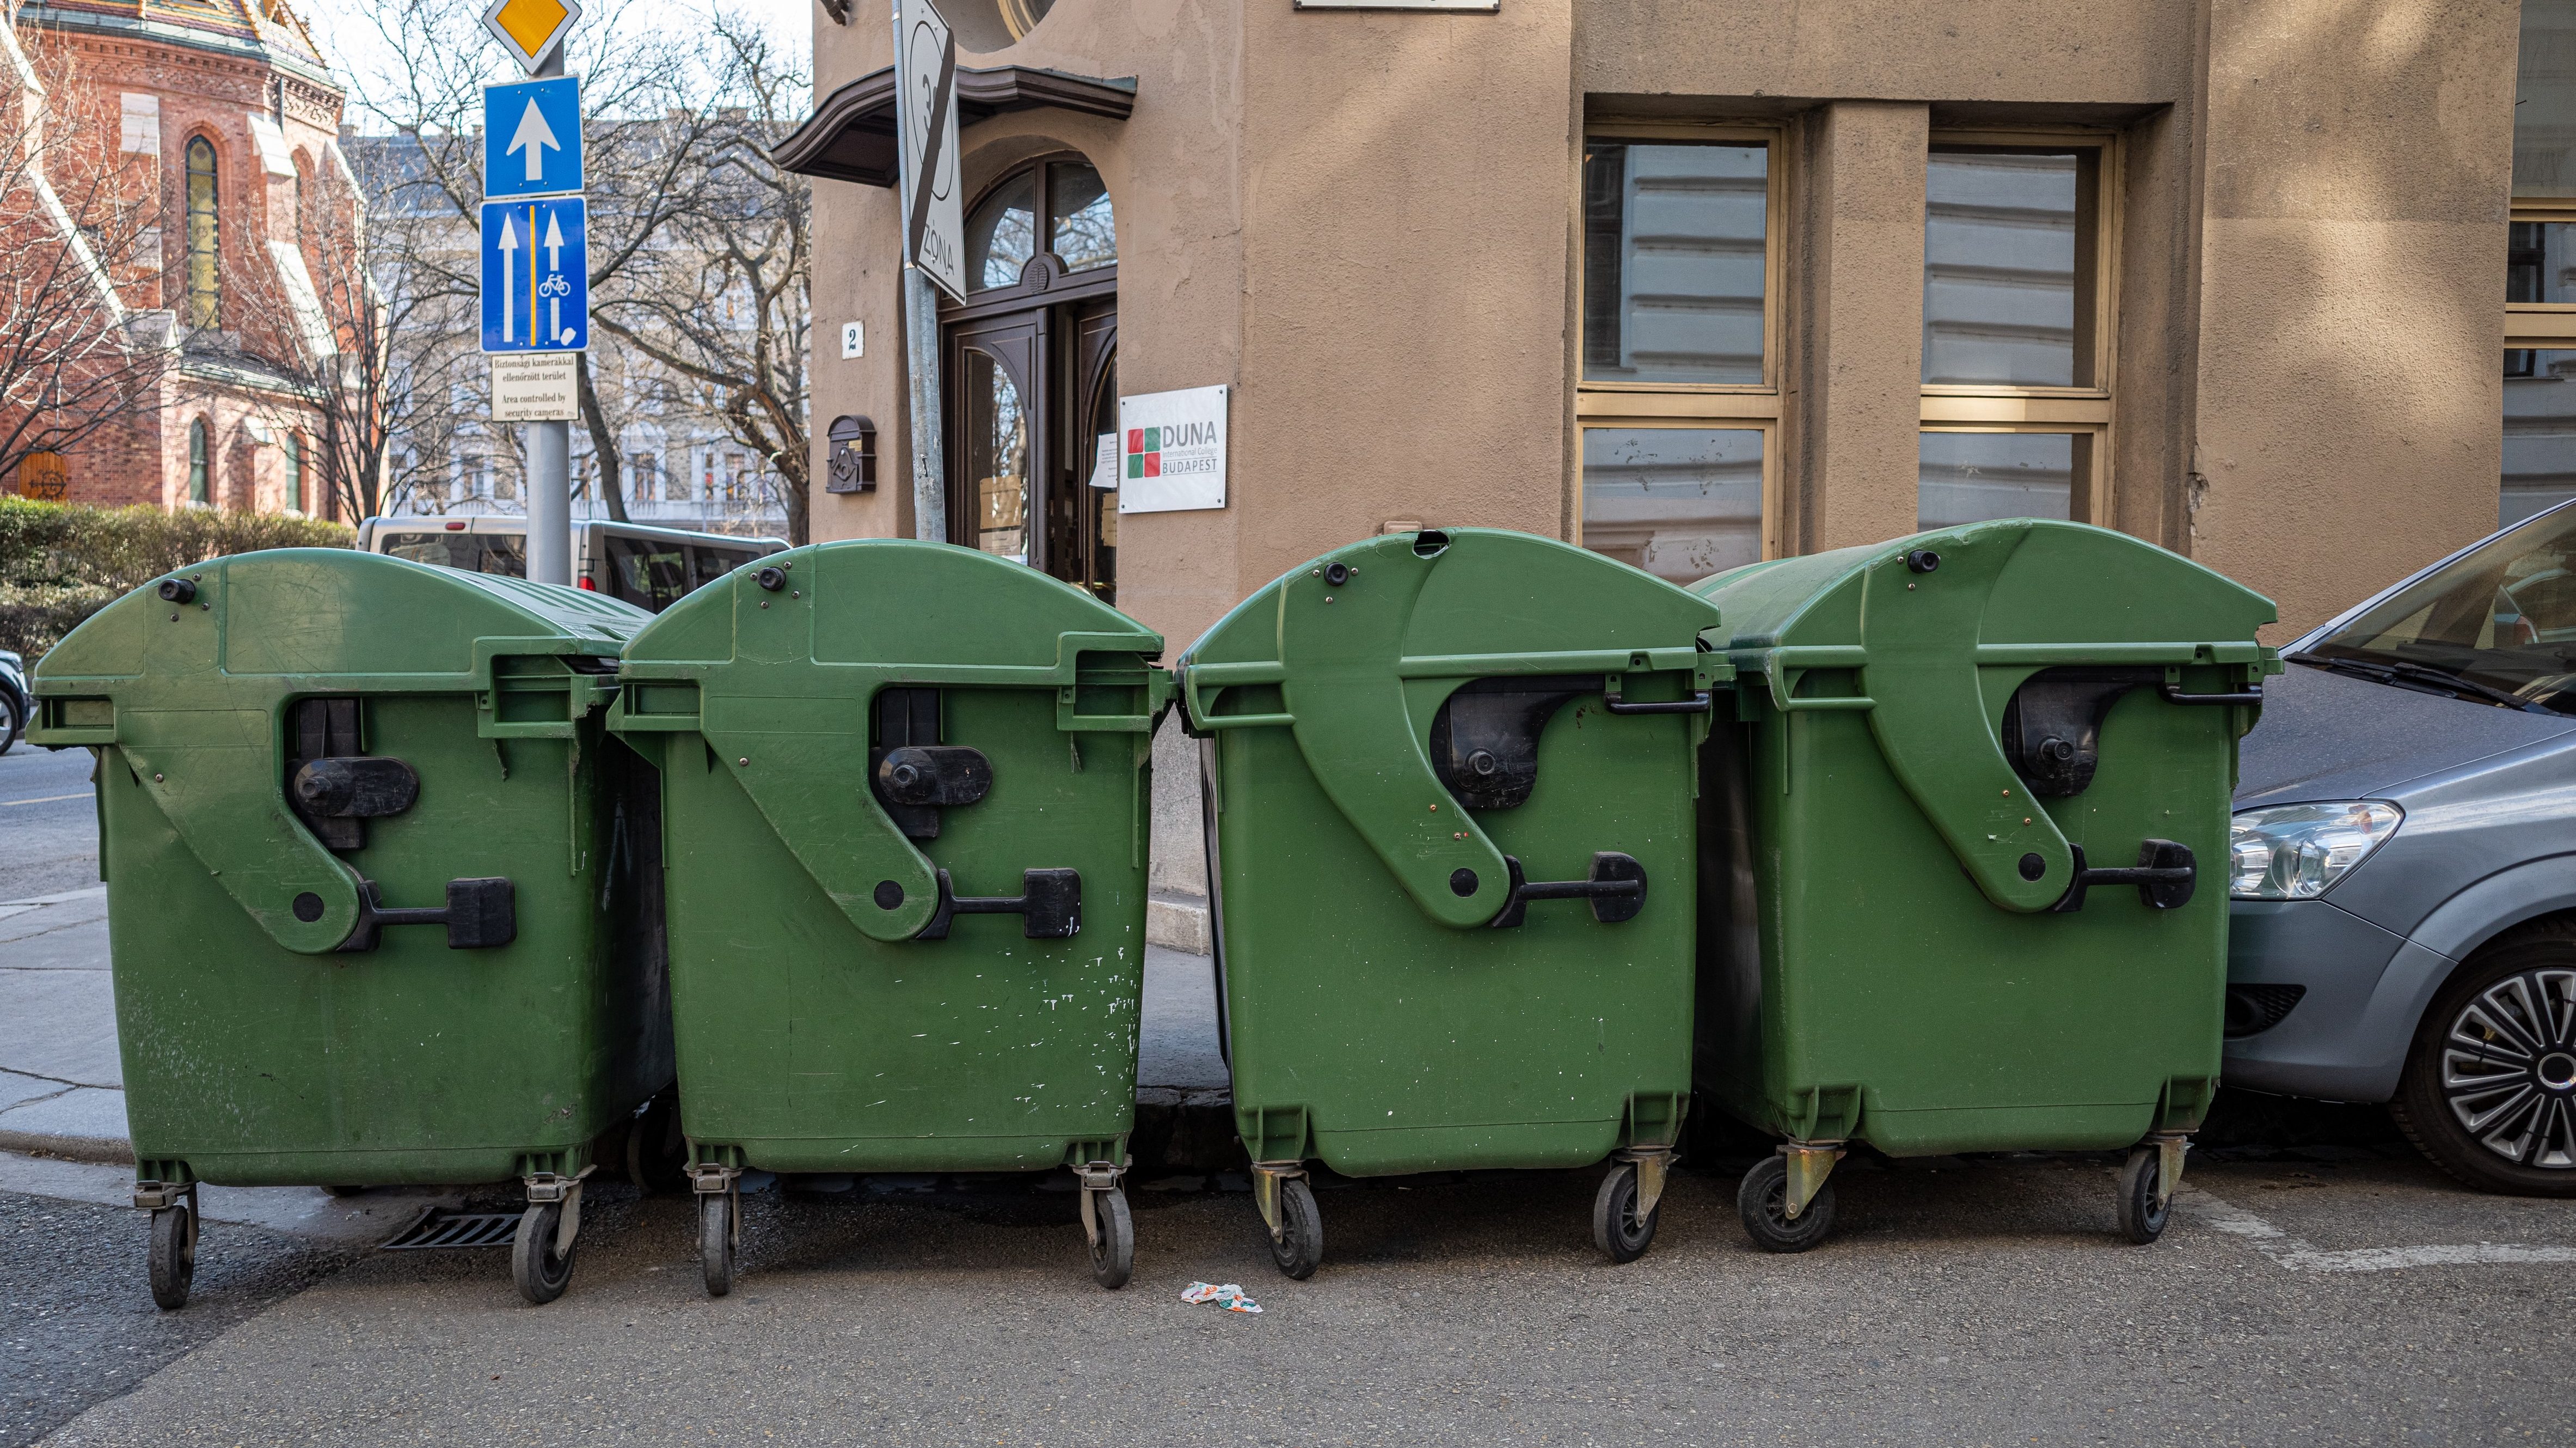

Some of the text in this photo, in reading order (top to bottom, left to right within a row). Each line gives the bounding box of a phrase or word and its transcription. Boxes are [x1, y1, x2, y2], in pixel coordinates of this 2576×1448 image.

[924, 219, 954, 276] ZÓNA
[849, 329, 856, 351] 2
[495, 356, 574, 368] Biztonsági kamerákkal
[542, 370, 566, 380] terület
[502, 392, 566, 404] Area controlled by
[505, 407, 532, 418] security
[1163, 421, 1217, 448] DUNA
[1163, 447, 1217, 458] International College
[1163, 459, 1217, 474] BUDAPEST
